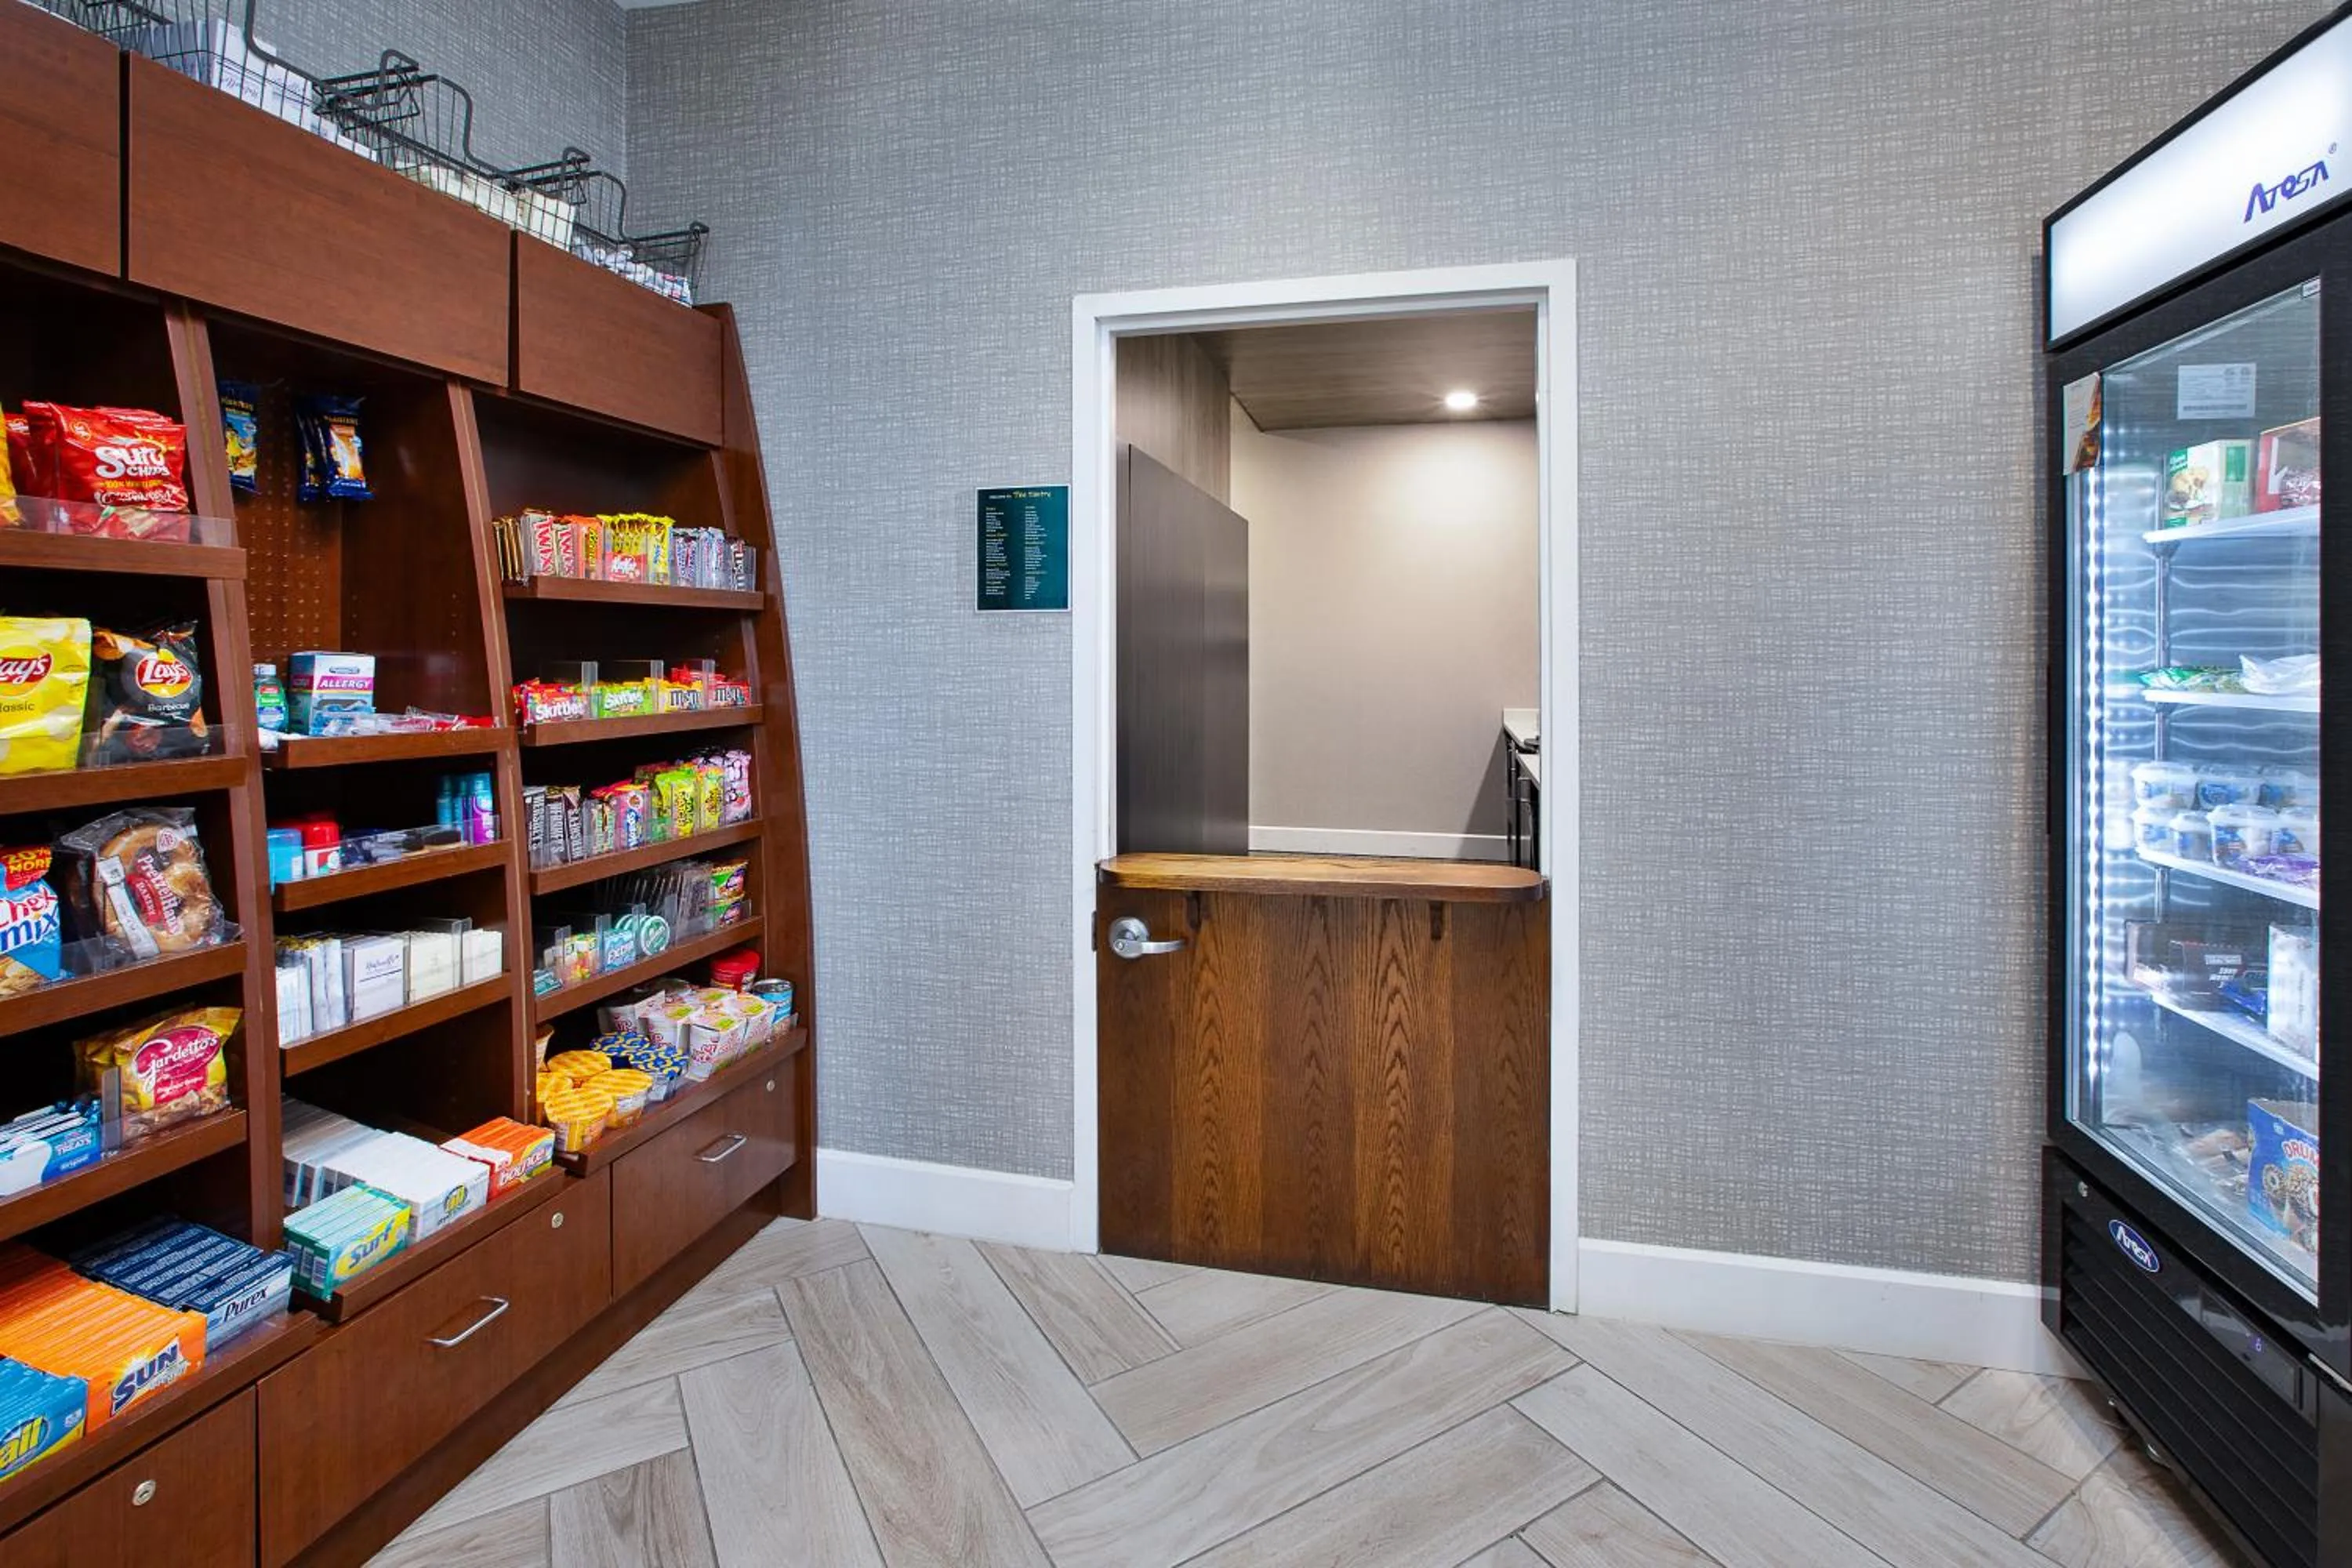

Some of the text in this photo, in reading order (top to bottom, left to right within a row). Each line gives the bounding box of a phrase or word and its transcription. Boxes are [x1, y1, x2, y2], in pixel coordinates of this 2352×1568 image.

[2244, 160, 2329, 223] ATOSA
[126, 465, 171, 477] CHIPS
[142, 656, 190, 685] Lay's
[319, 679, 370, 688] ALLERGY
[0, 701, 35, 713] lassic
[348, 1217, 395, 1269] Surf
[223, 1284, 269, 1323] Purex
[114, 1342, 179, 1413] SUN
[0, 1417, 43, 1469] all
